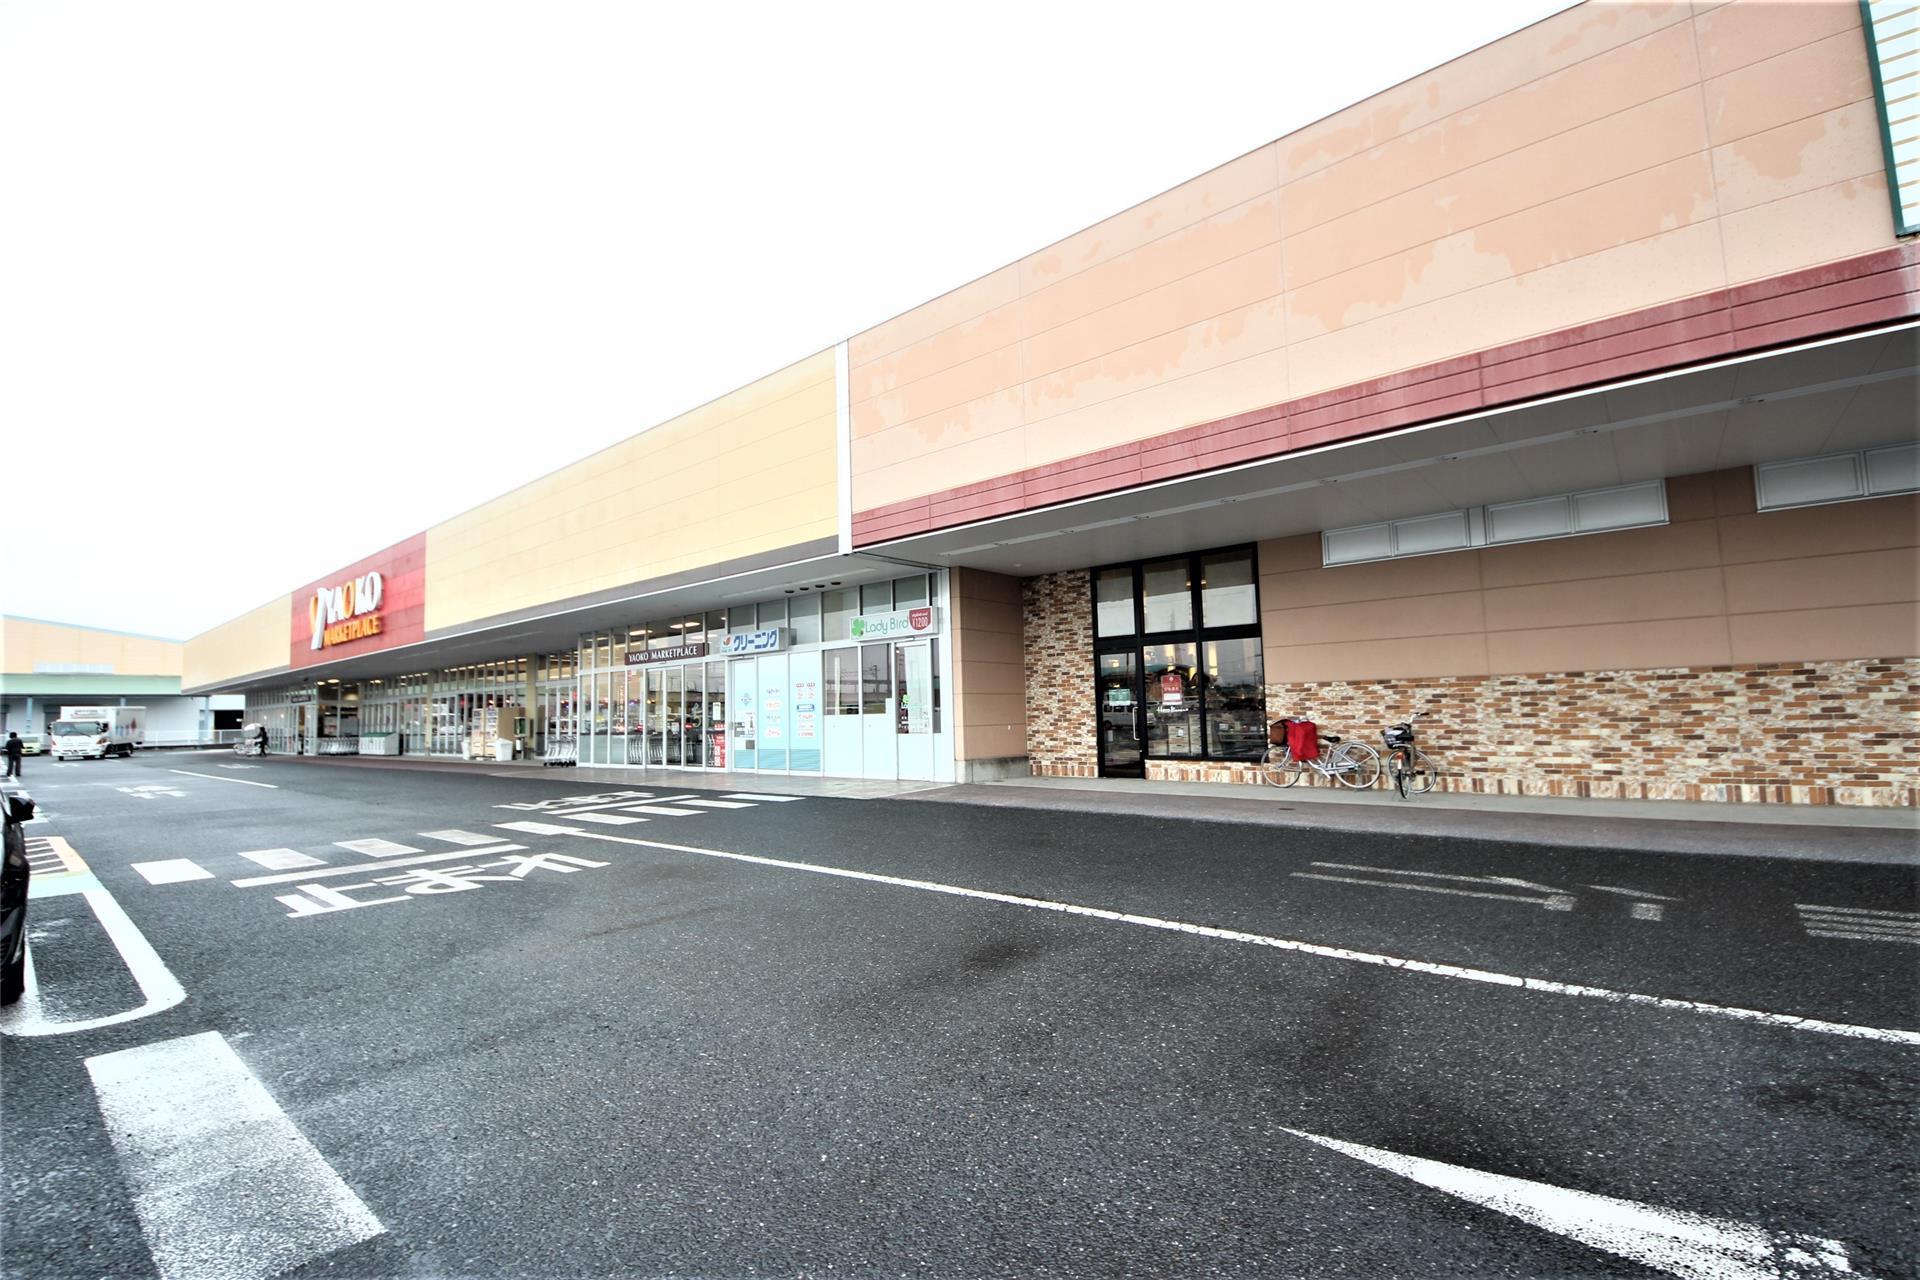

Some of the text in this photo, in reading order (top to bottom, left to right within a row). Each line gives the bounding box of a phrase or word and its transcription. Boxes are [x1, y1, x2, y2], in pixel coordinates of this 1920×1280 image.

[323, 615, 381, 647] MARKETPLACE
[865, 616, 909, 634] Lady Bird
[733, 629, 778, 652] クリーニング
[628, 645, 698, 663] YAOKO MARKETPLACE
[274, 853, 612, 918] 止まれ
